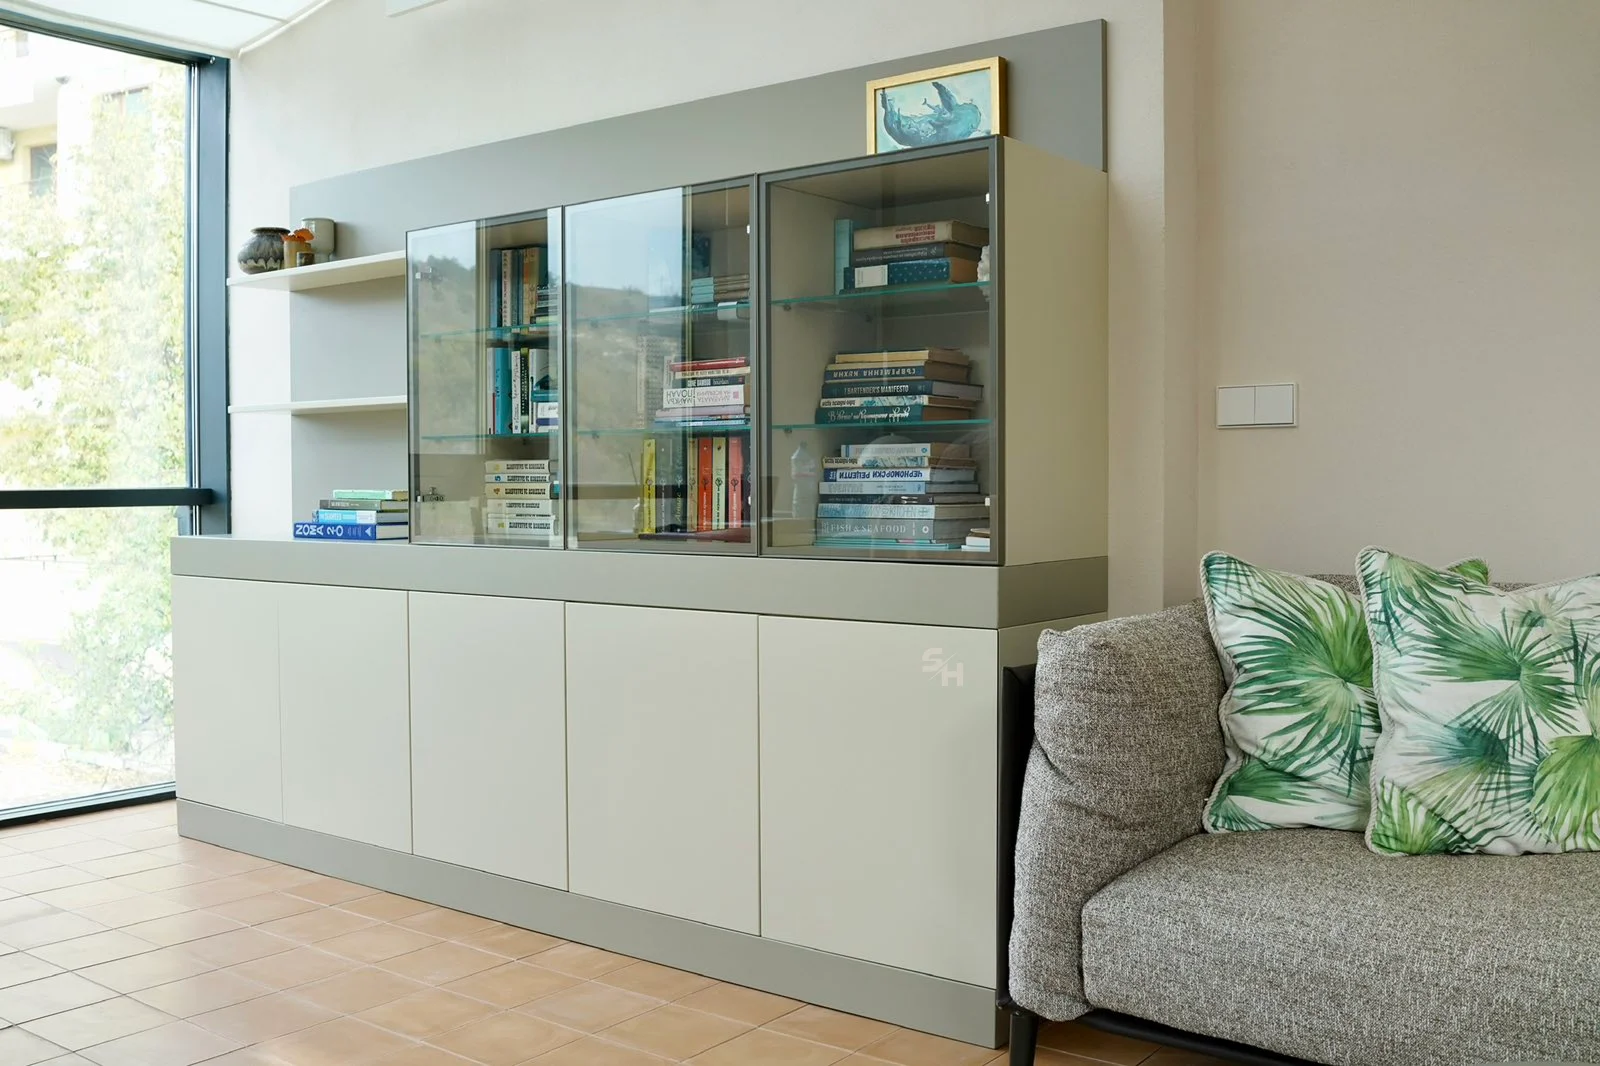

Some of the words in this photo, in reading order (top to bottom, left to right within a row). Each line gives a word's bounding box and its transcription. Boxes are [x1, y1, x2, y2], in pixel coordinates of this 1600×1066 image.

[863, 368, 916, 377] СЪВРЕМЕННА
[846, 385, 880, 395] BARTENDER'S
[880, 384, 909, 394] MANIFESTO
[839, 471, 870, 480] РЕЦЕПТИ
[872, 470, 923, 479] ЧЕРНОМОРСКИ
[295, 524, 324, 536] NOMA
[860, 524, 907, 534] SEAFOOD
